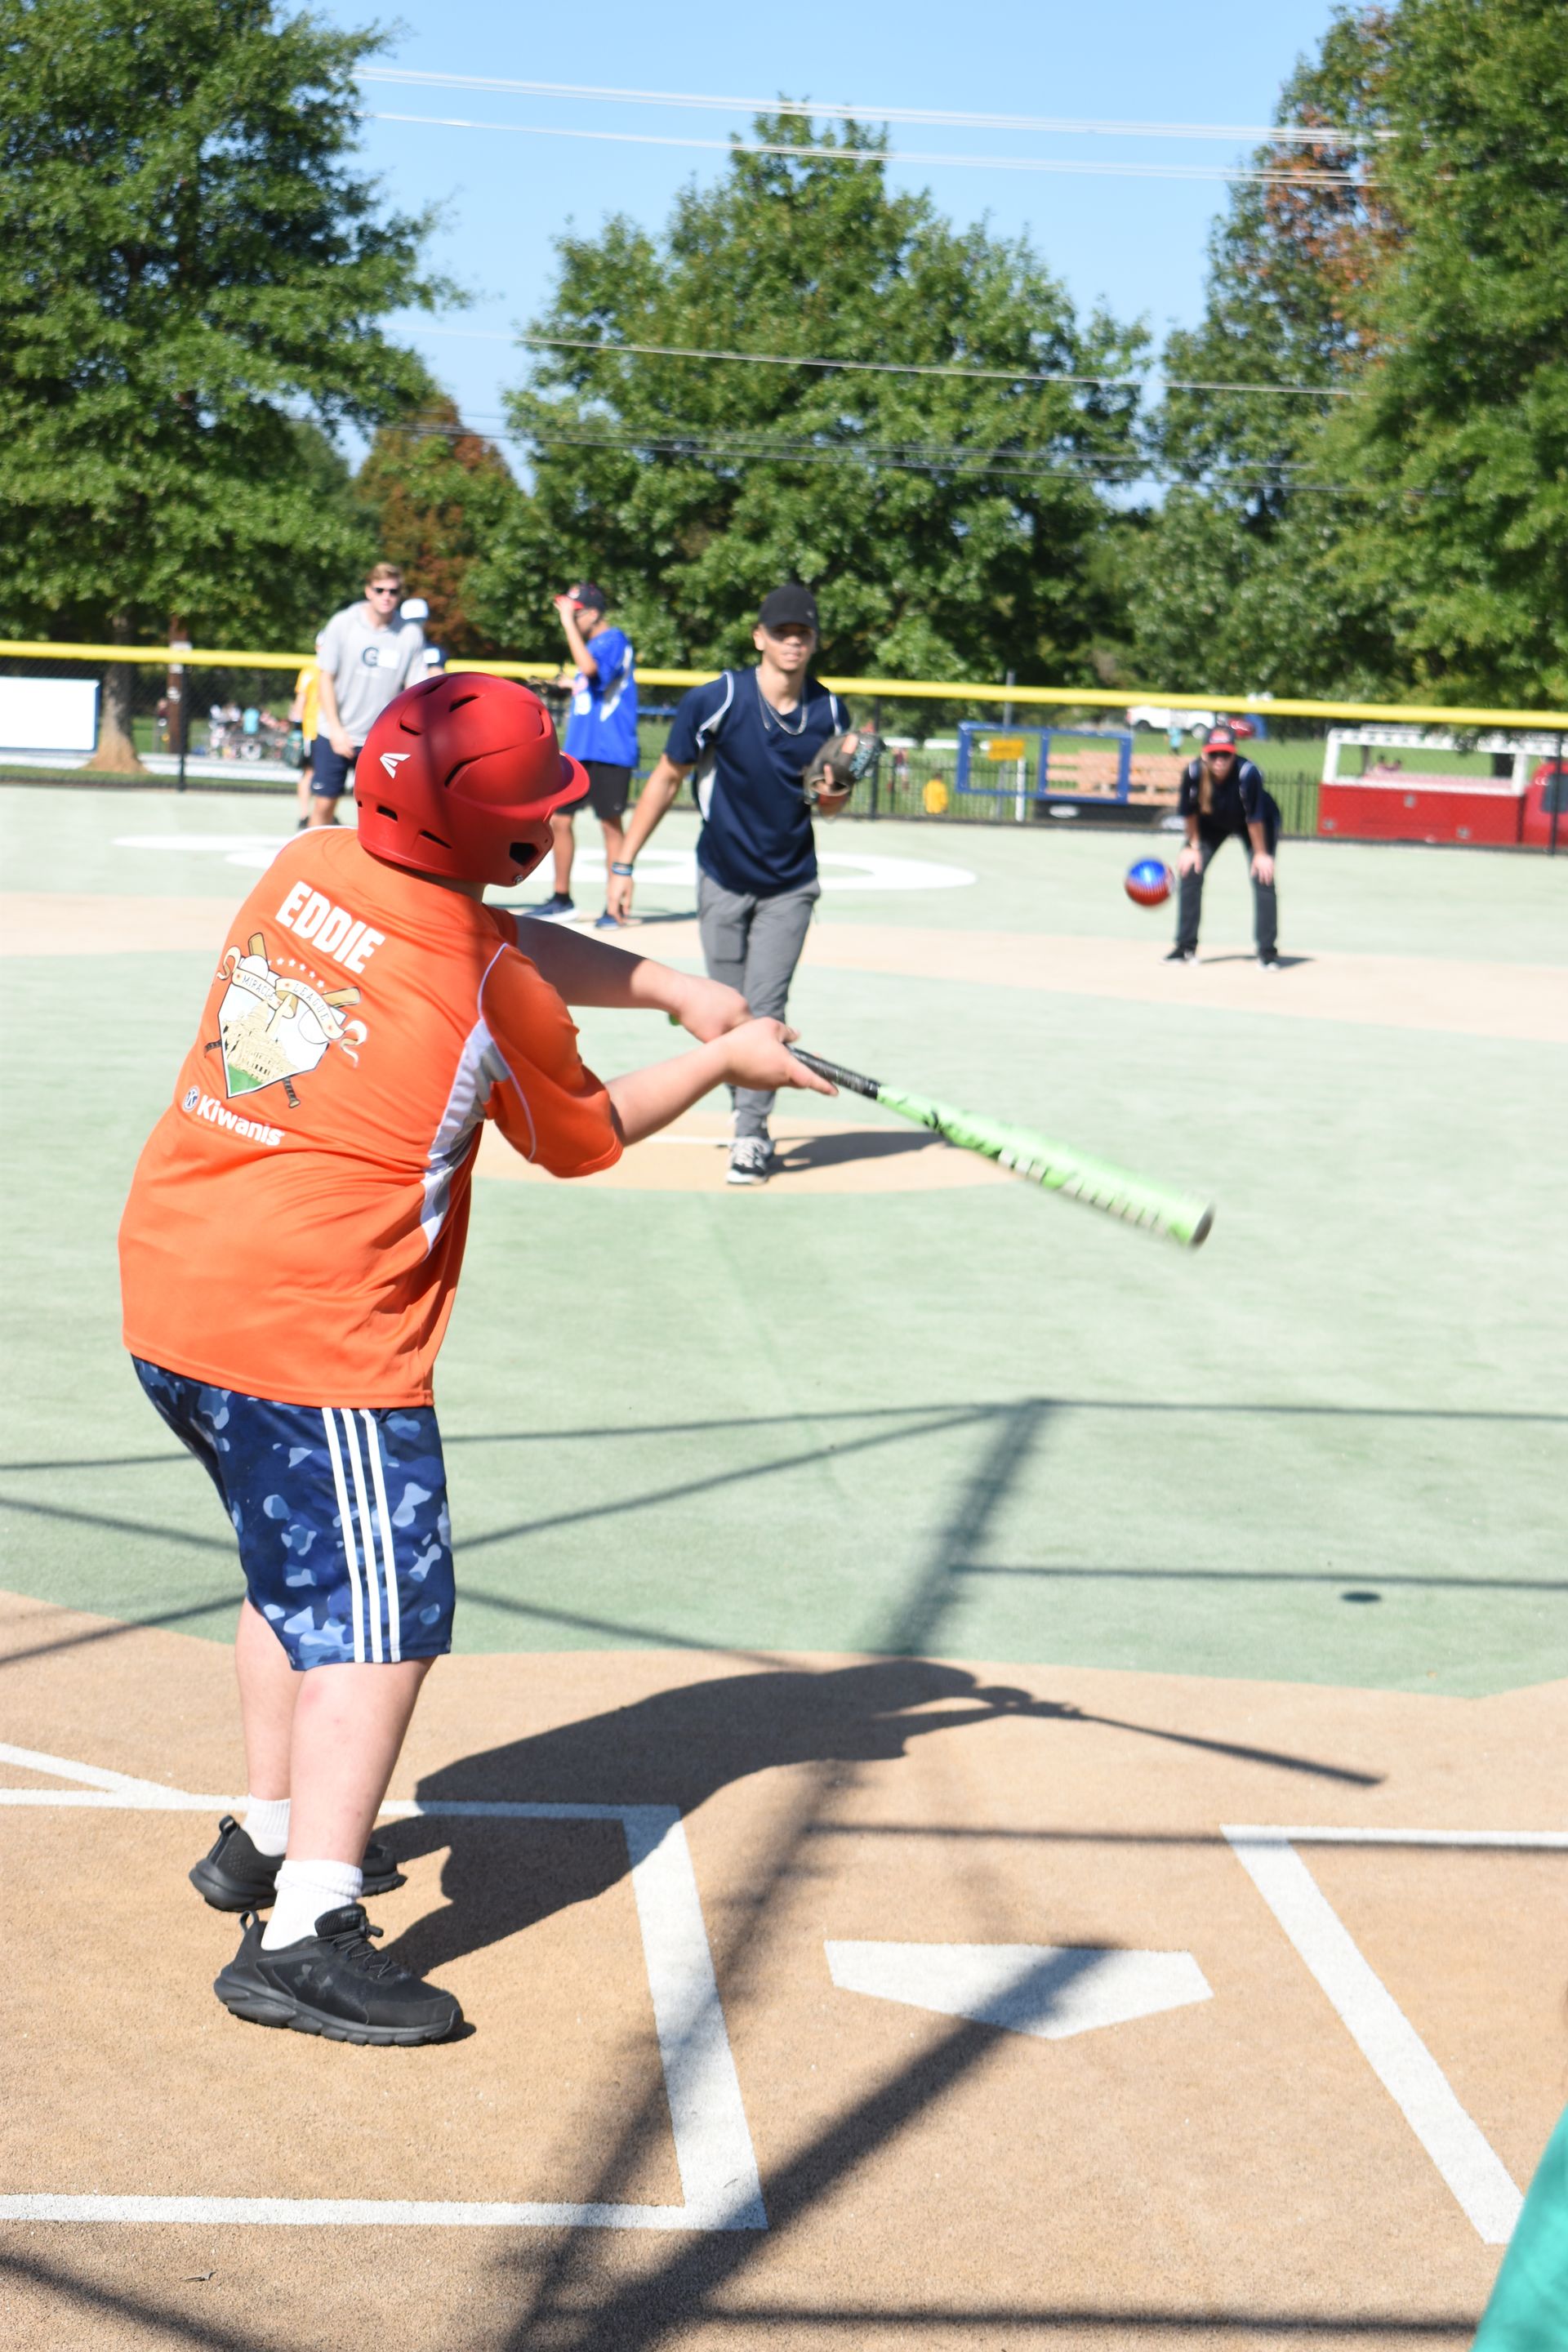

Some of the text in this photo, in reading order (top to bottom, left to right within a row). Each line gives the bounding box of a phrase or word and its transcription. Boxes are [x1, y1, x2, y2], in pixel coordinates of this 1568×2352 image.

[275, 880, 385, 974] EDDIE
[242, 974, 330, 1021] MIRACLE LEAGUE
[197, 1094, 285, 1146] Kiwanis
